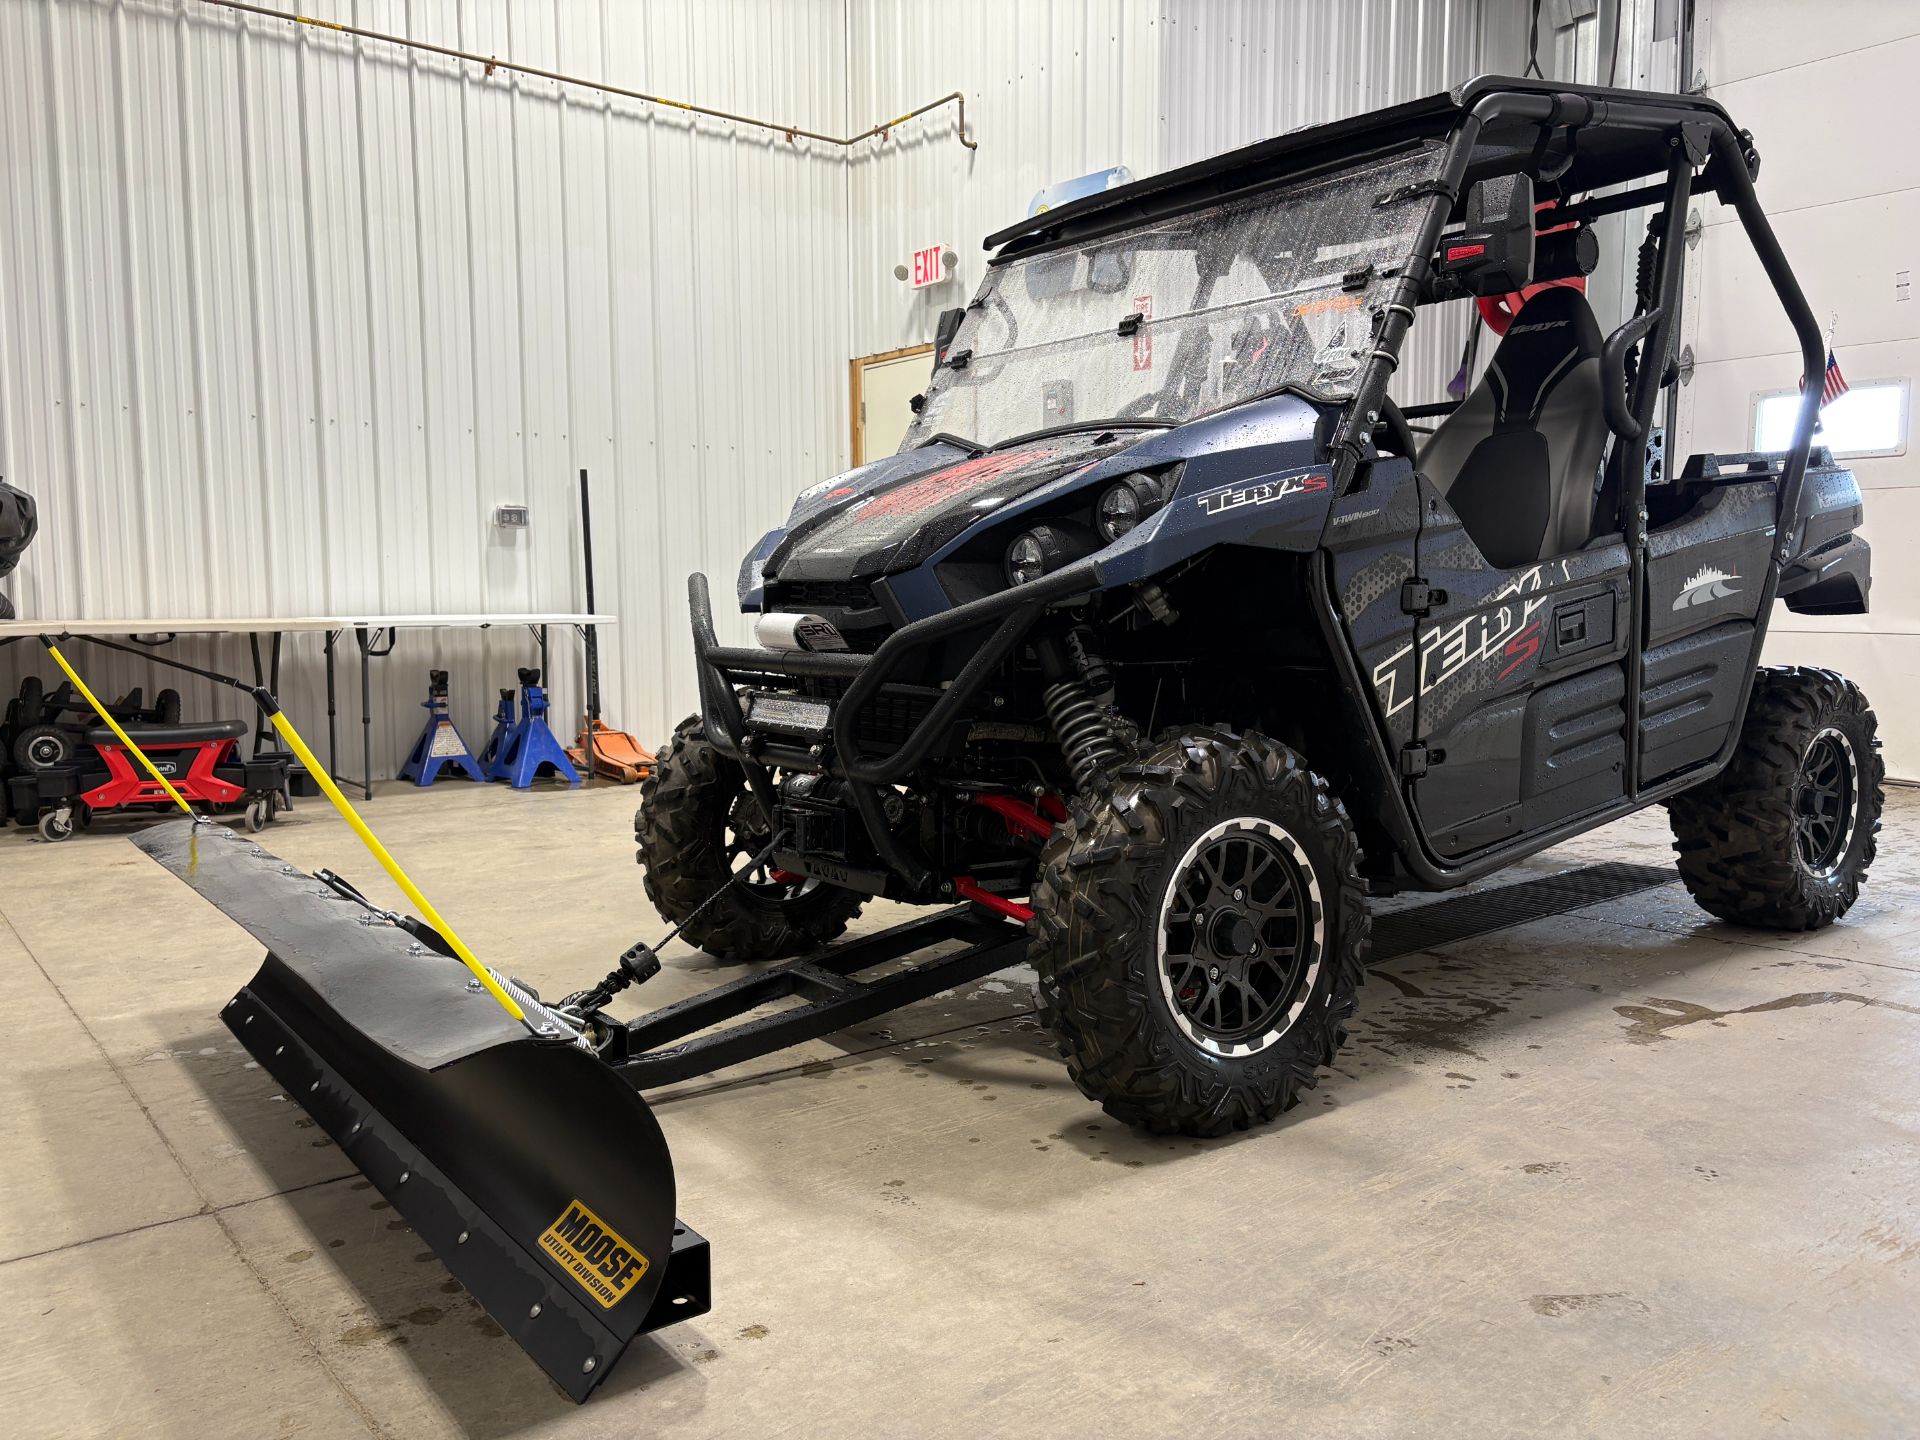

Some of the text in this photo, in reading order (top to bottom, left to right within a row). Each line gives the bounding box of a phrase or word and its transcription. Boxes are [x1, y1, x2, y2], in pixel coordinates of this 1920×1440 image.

[914, 246, 941, 285] EXIT
[543, 1234, 617, 1303] UTILITY DIVISION
[555, 1206, 643, 1291] MOOSE
